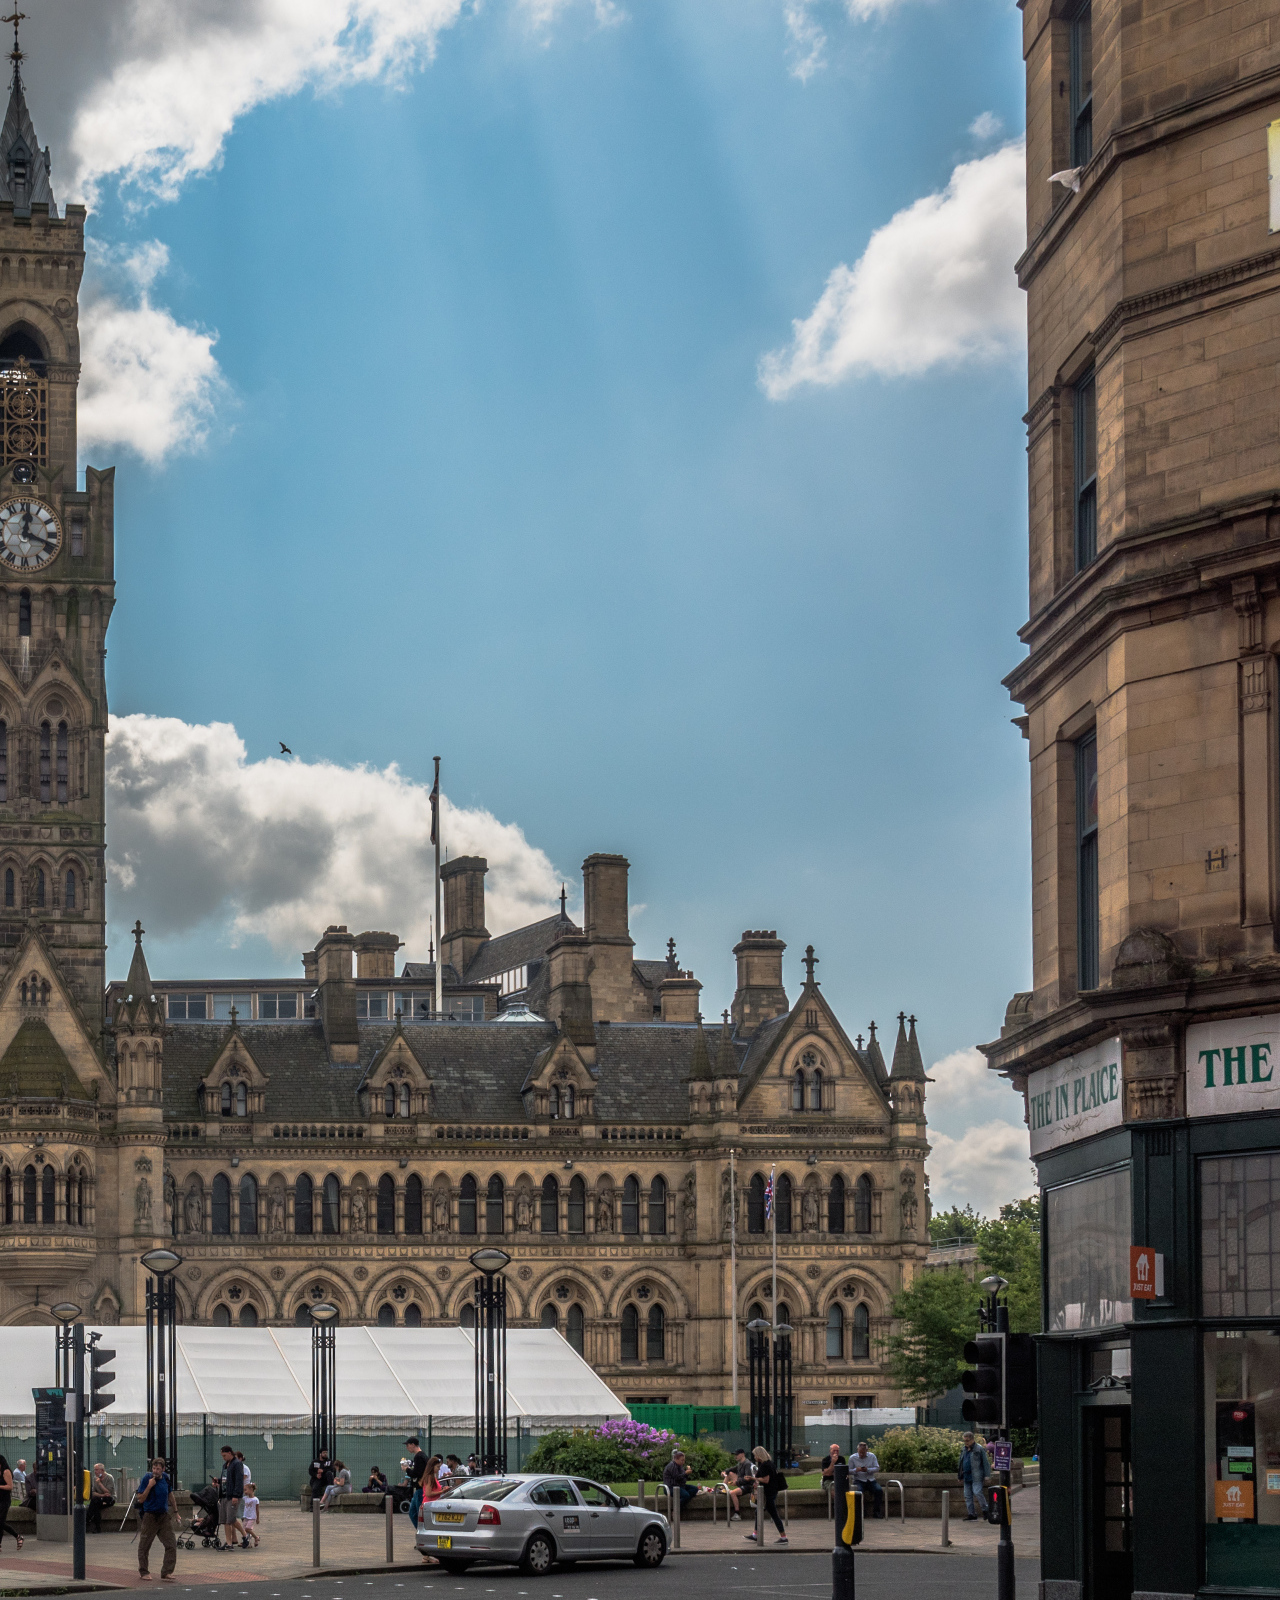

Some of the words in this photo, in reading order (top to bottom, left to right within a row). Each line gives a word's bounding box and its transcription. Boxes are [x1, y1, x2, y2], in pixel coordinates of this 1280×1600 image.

[1198, 1043, 1274, 1089] THE
[1030, 1092, 1052, 1131] THE
[1055, 1082, 1069, 1122] IN
[1073, 1062, 1119, 1116] PLAICE
[1133, 1283, 1144, 1291] JUST
[1144, 1284, 1152, 1292] EAT
